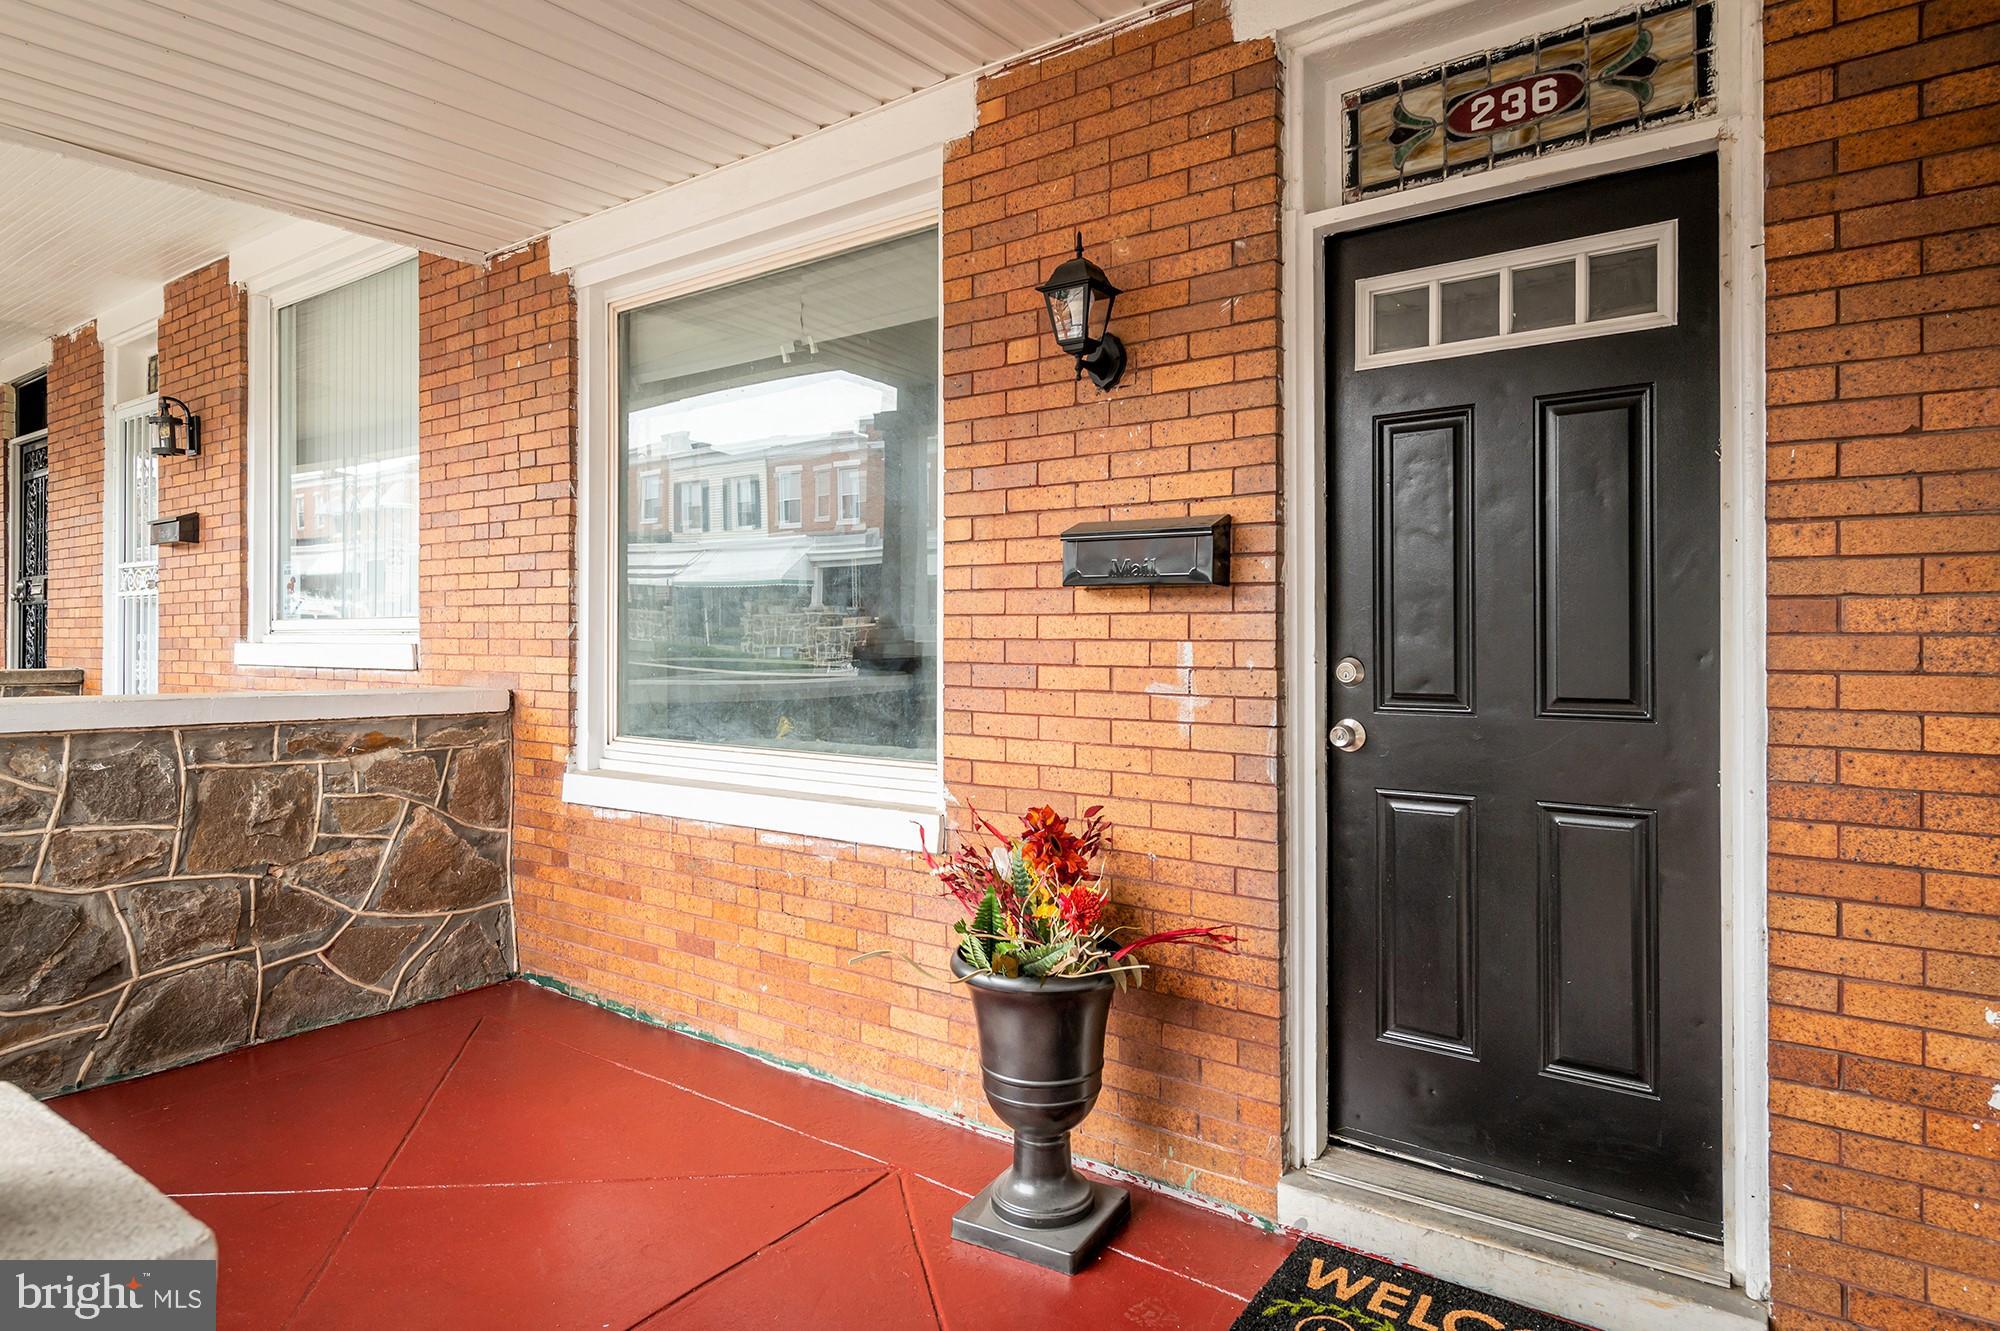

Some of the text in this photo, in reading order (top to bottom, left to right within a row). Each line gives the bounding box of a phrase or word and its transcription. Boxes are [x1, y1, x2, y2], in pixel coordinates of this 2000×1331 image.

[1470, 77, 1558, 132] 236
[1110, 557, 1158, 577] Mail
[1306, 1257, 1534, 1331] WELC
